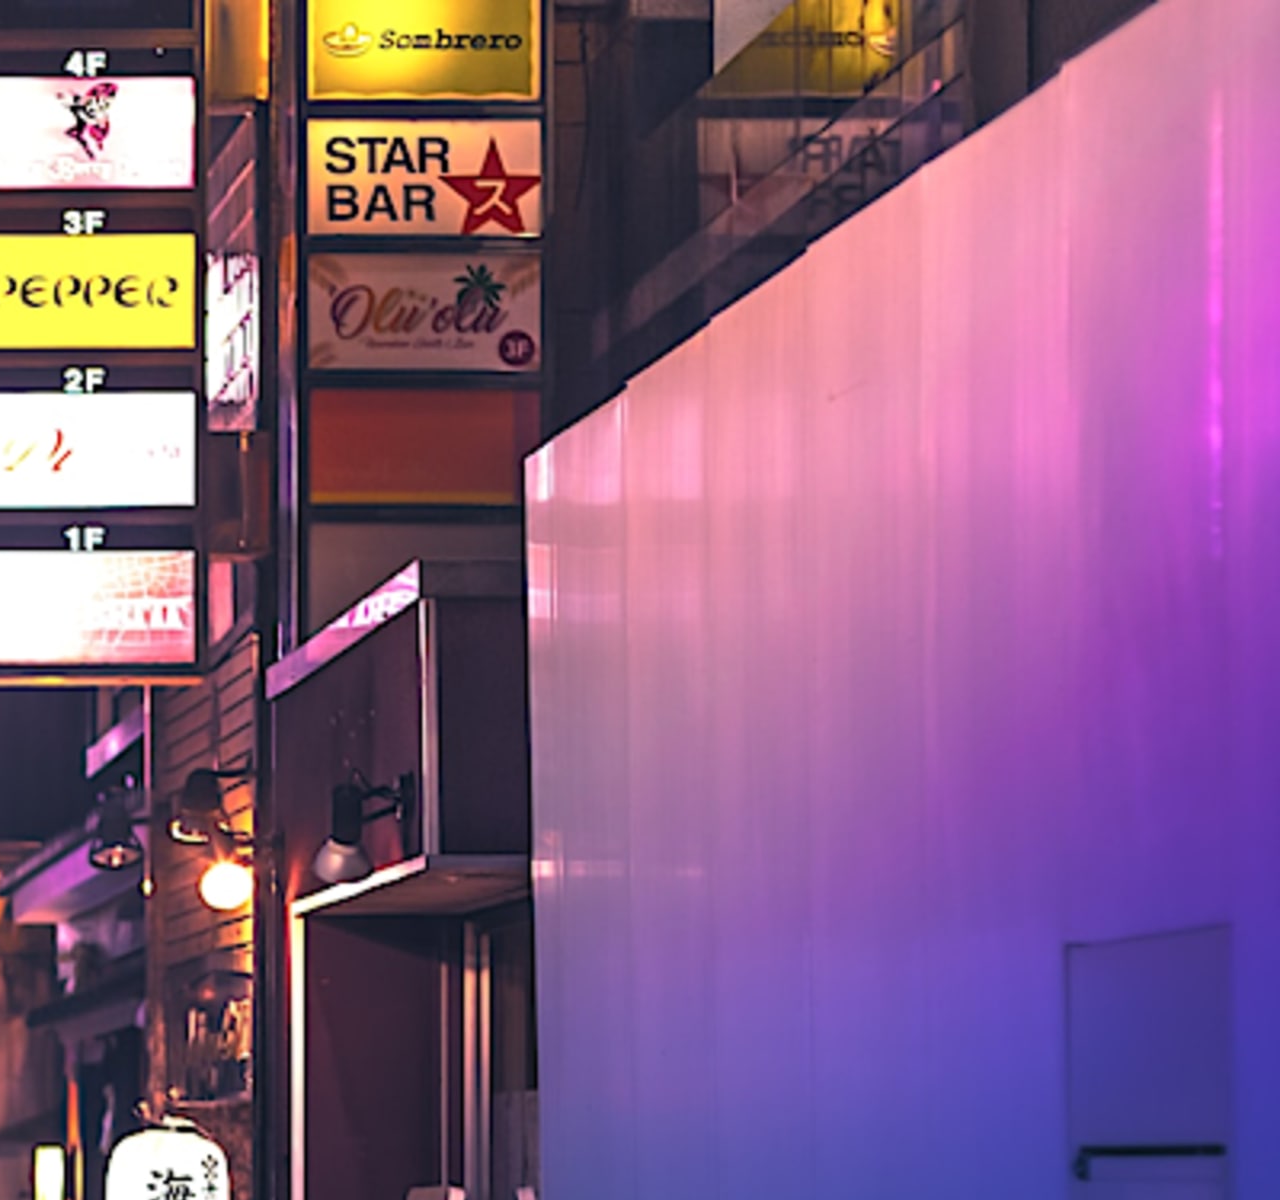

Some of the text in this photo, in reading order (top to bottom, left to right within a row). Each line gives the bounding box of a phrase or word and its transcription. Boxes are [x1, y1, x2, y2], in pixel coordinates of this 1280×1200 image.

[377, 28, 523, 53] Sombrero
[64, 50, 108, 76] 4F
[324, 136, 450, 175] STAR
[327, 184, 437, 222] BAR
[474, 179, 512, 214] ス
[63, 210, 106, 234] 3F
[63, 368, 106, 393] 2F
[63, 526, 106, 551] 1F
